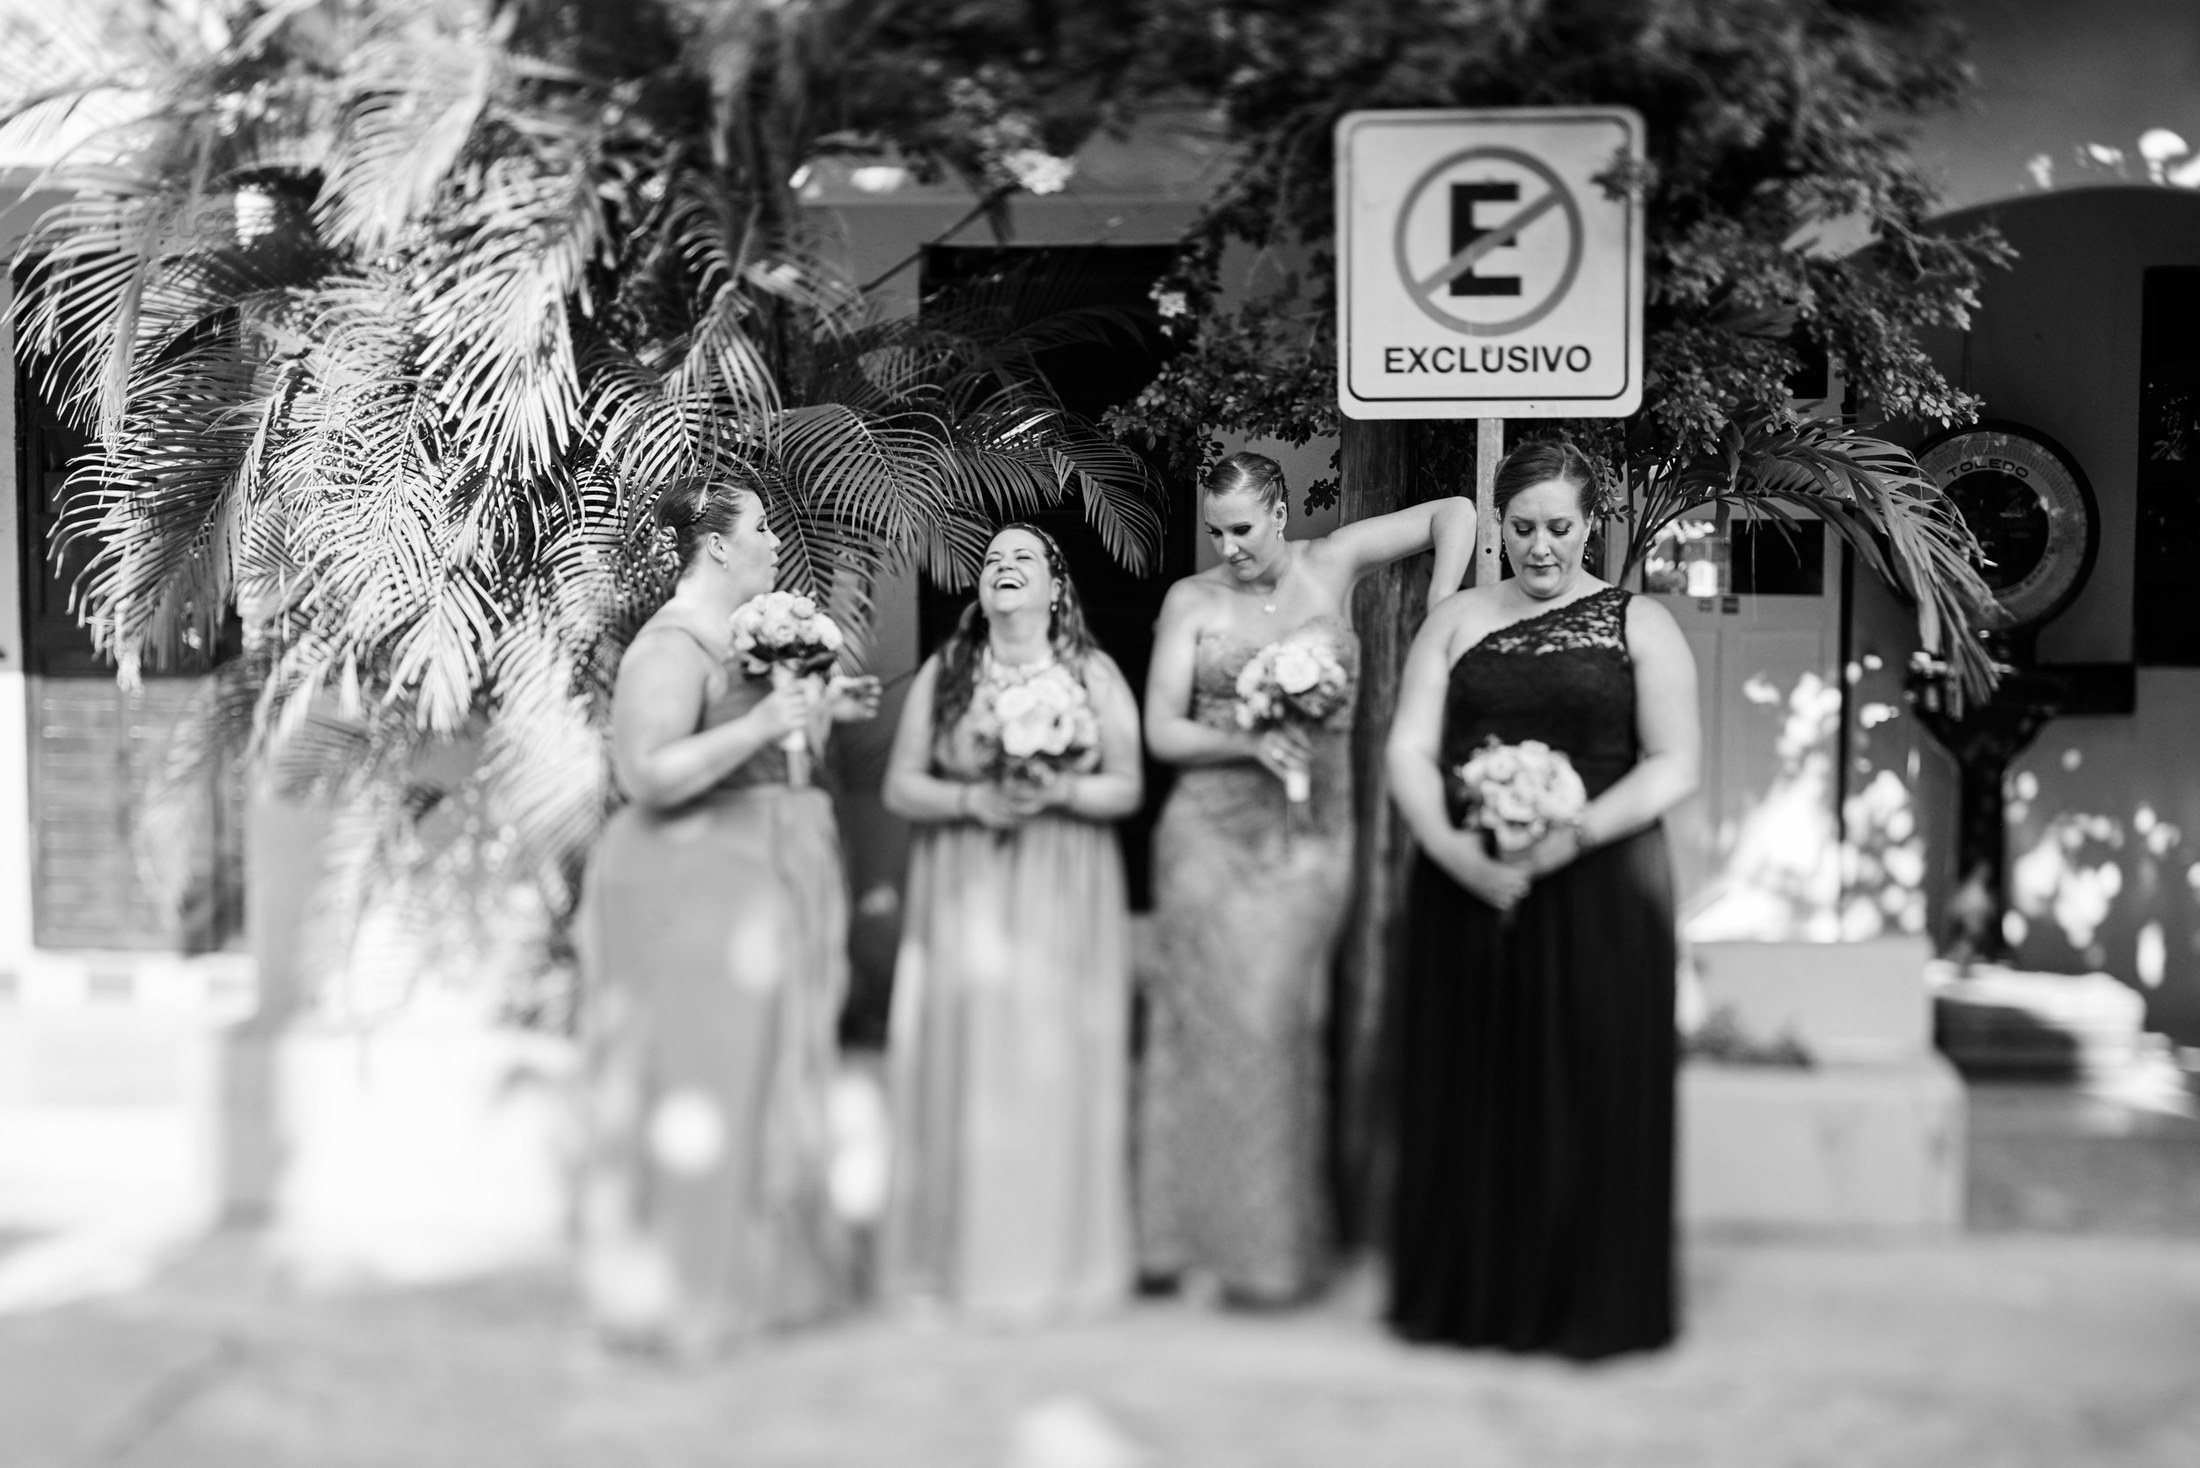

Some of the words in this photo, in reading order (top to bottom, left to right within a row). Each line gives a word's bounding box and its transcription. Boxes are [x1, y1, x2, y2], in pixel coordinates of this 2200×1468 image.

[1449, 182, 1522, 297] E
[1384, 344, 1593, 375] EXCLUSIVO
[1946, 457, 2029, 479] TOLEDO
